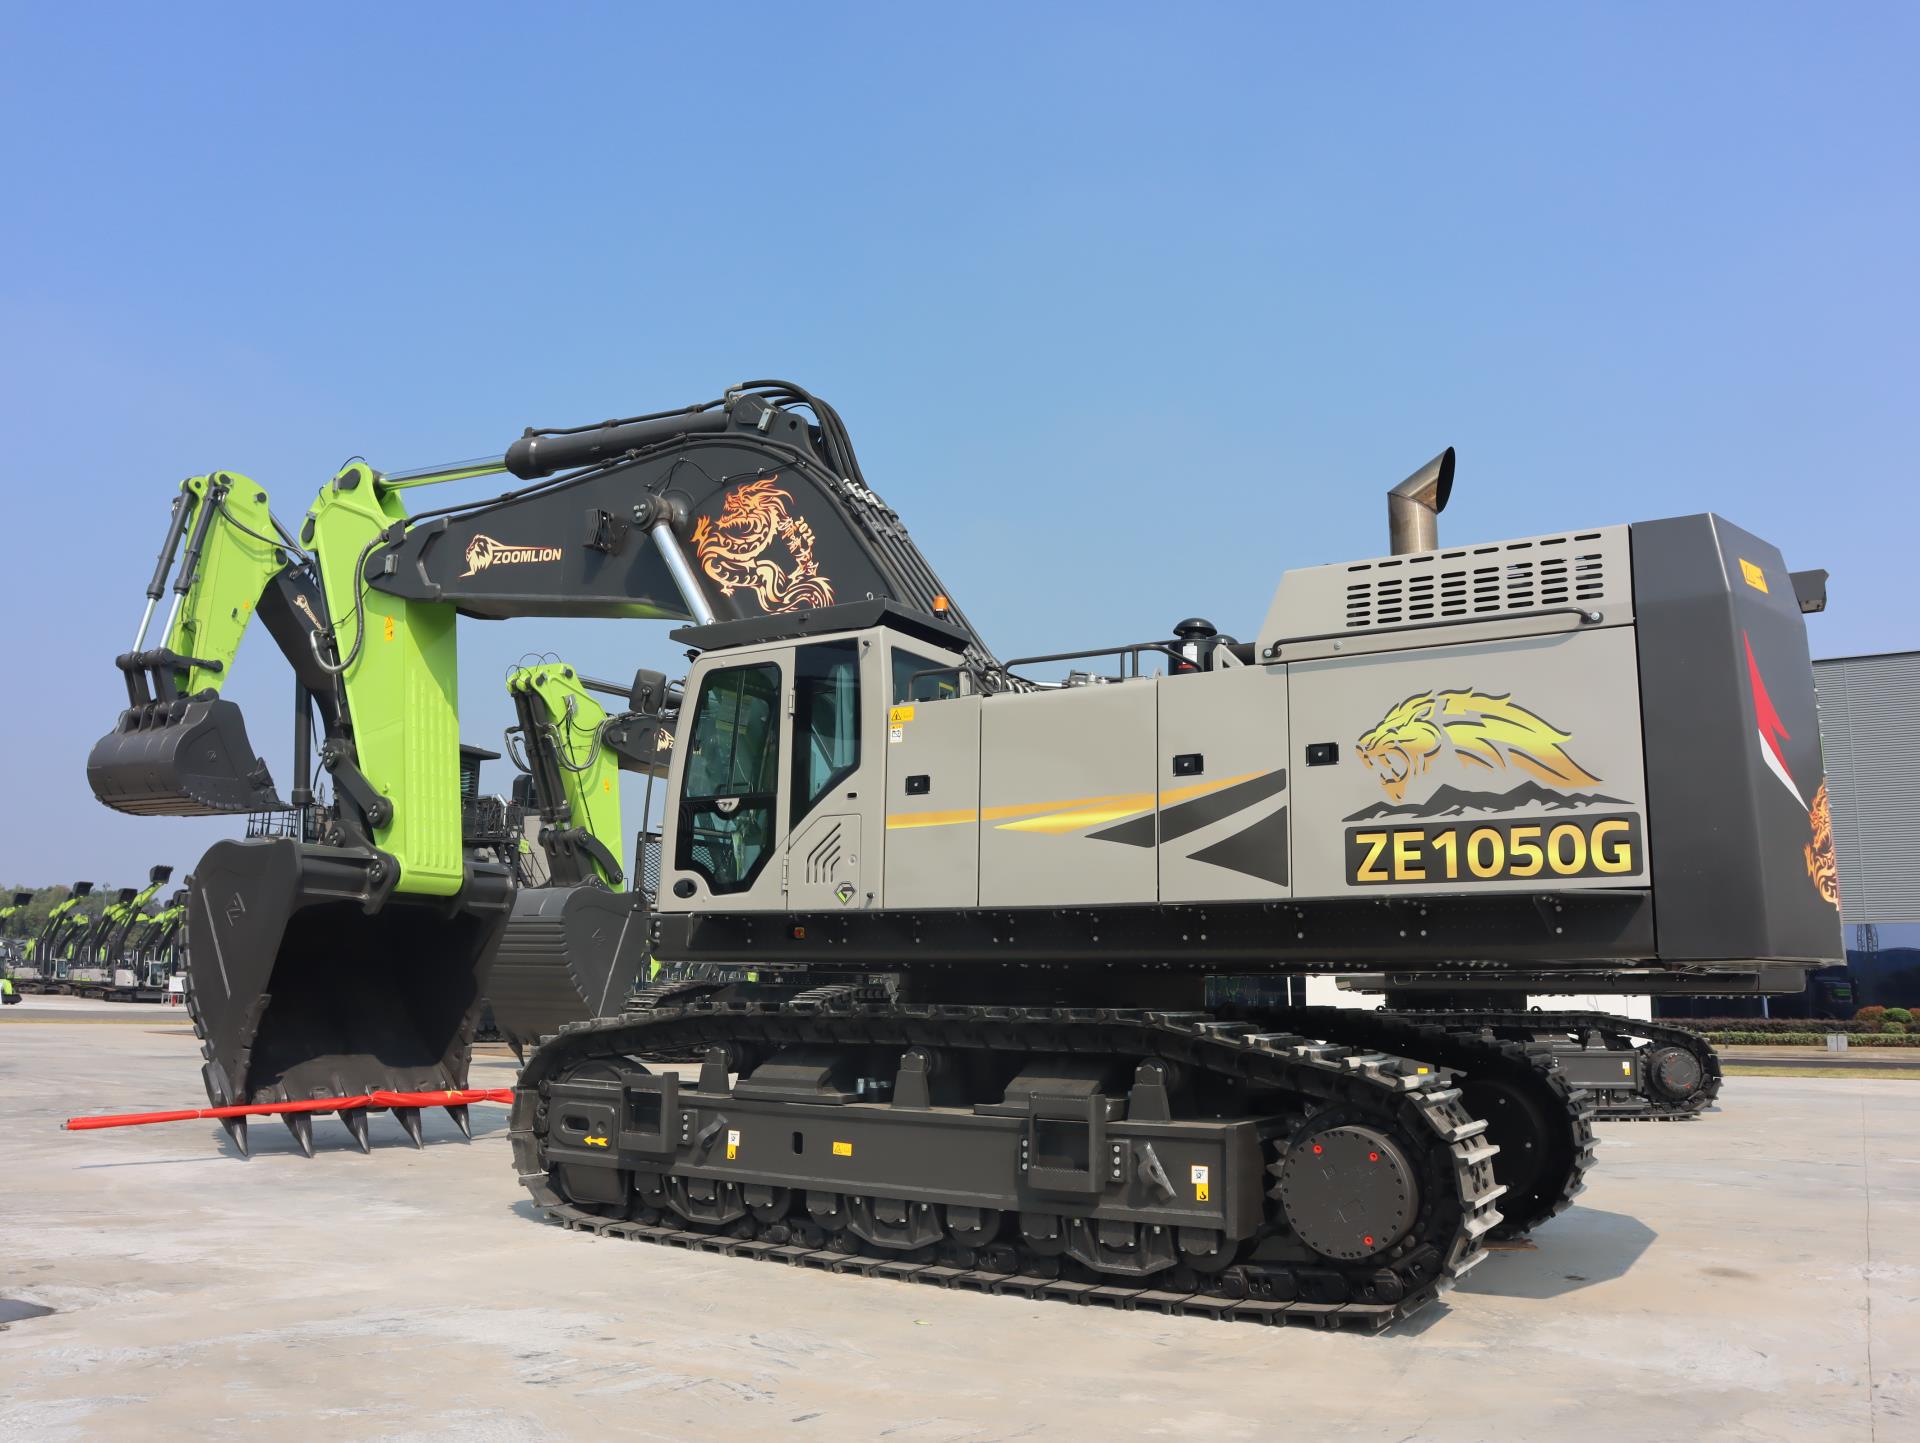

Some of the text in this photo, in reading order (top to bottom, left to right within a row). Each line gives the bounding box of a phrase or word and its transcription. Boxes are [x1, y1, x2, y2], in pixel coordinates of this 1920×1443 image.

[795, 516, 815, 545] 2024
[493, 548, 562, 564] ZOOMLION
[1355, 817, 1632, 881] ZE1050G
